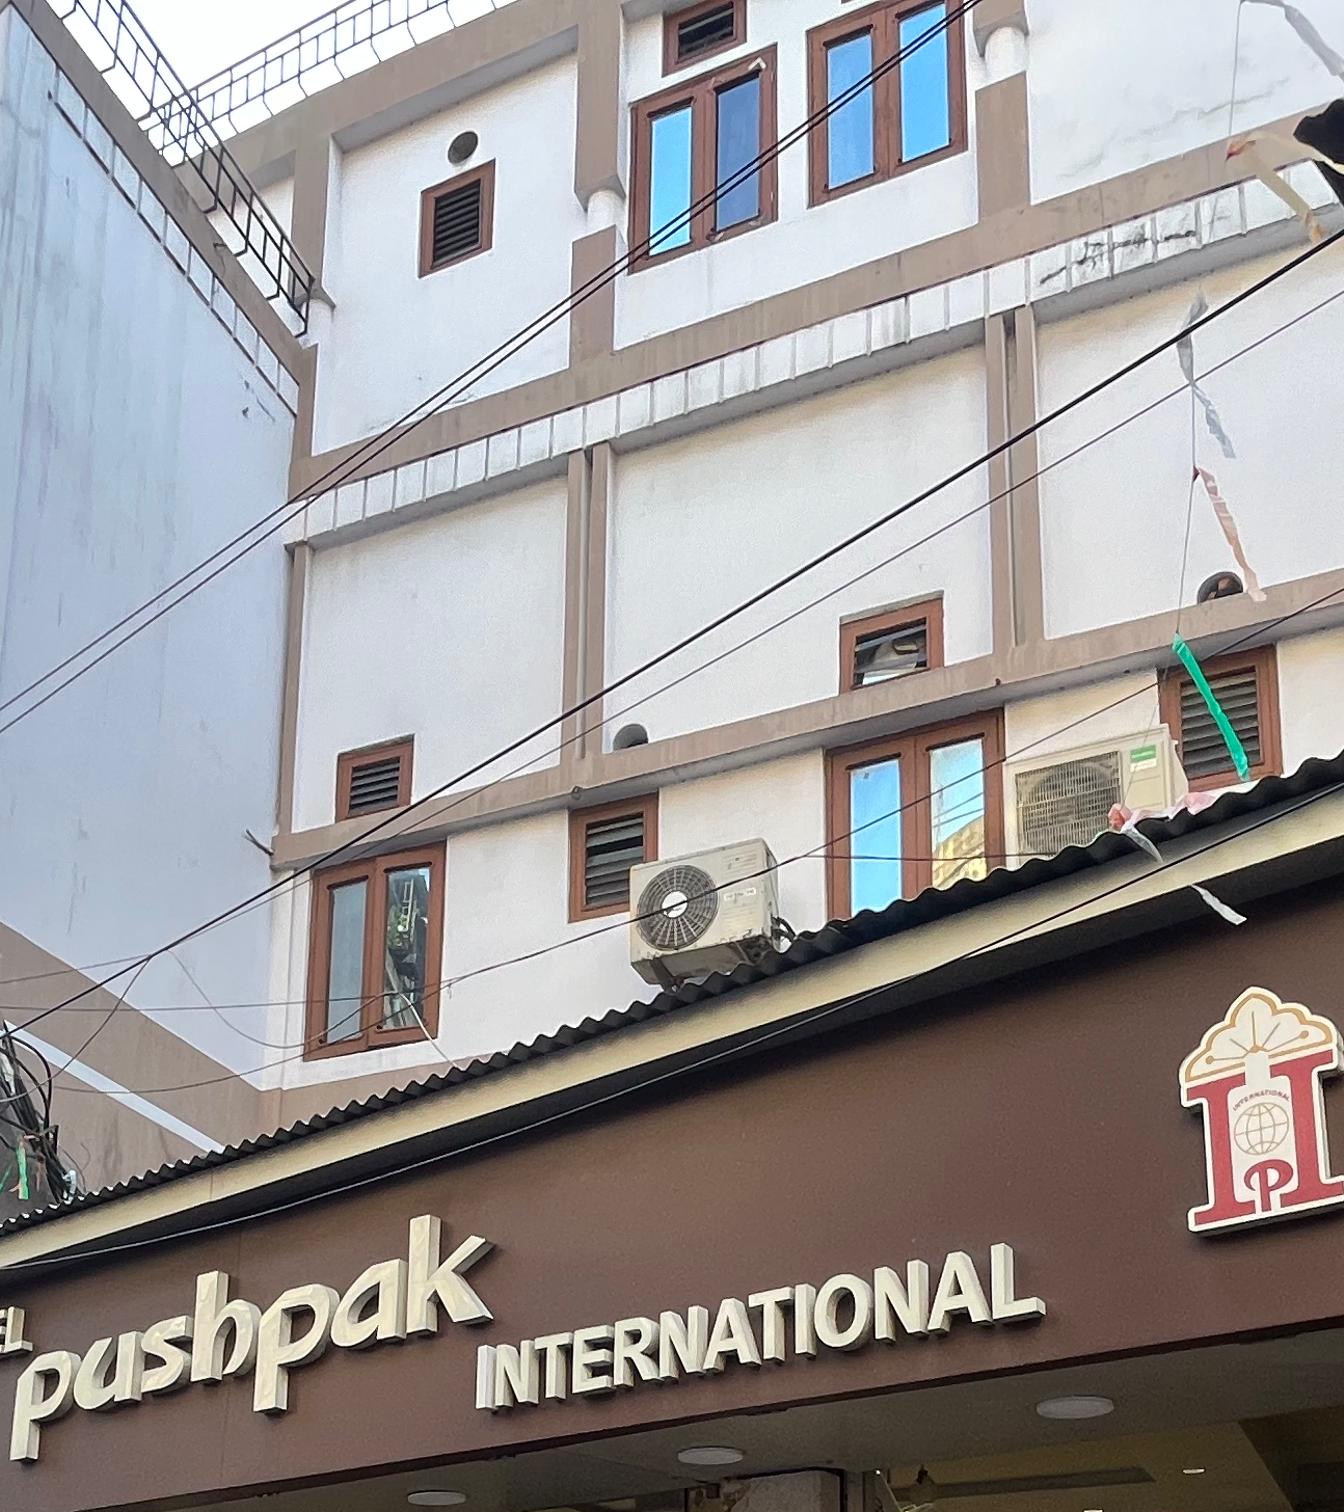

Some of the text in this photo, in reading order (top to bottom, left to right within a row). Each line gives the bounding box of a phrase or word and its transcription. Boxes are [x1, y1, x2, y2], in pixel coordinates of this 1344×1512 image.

[1232, 1089, 1290, 1111] INTERNATIONAL
[9, 1213, 497, 1465] pushpak
[475, 1241, 1047, 1412] INTERNATIONAL
